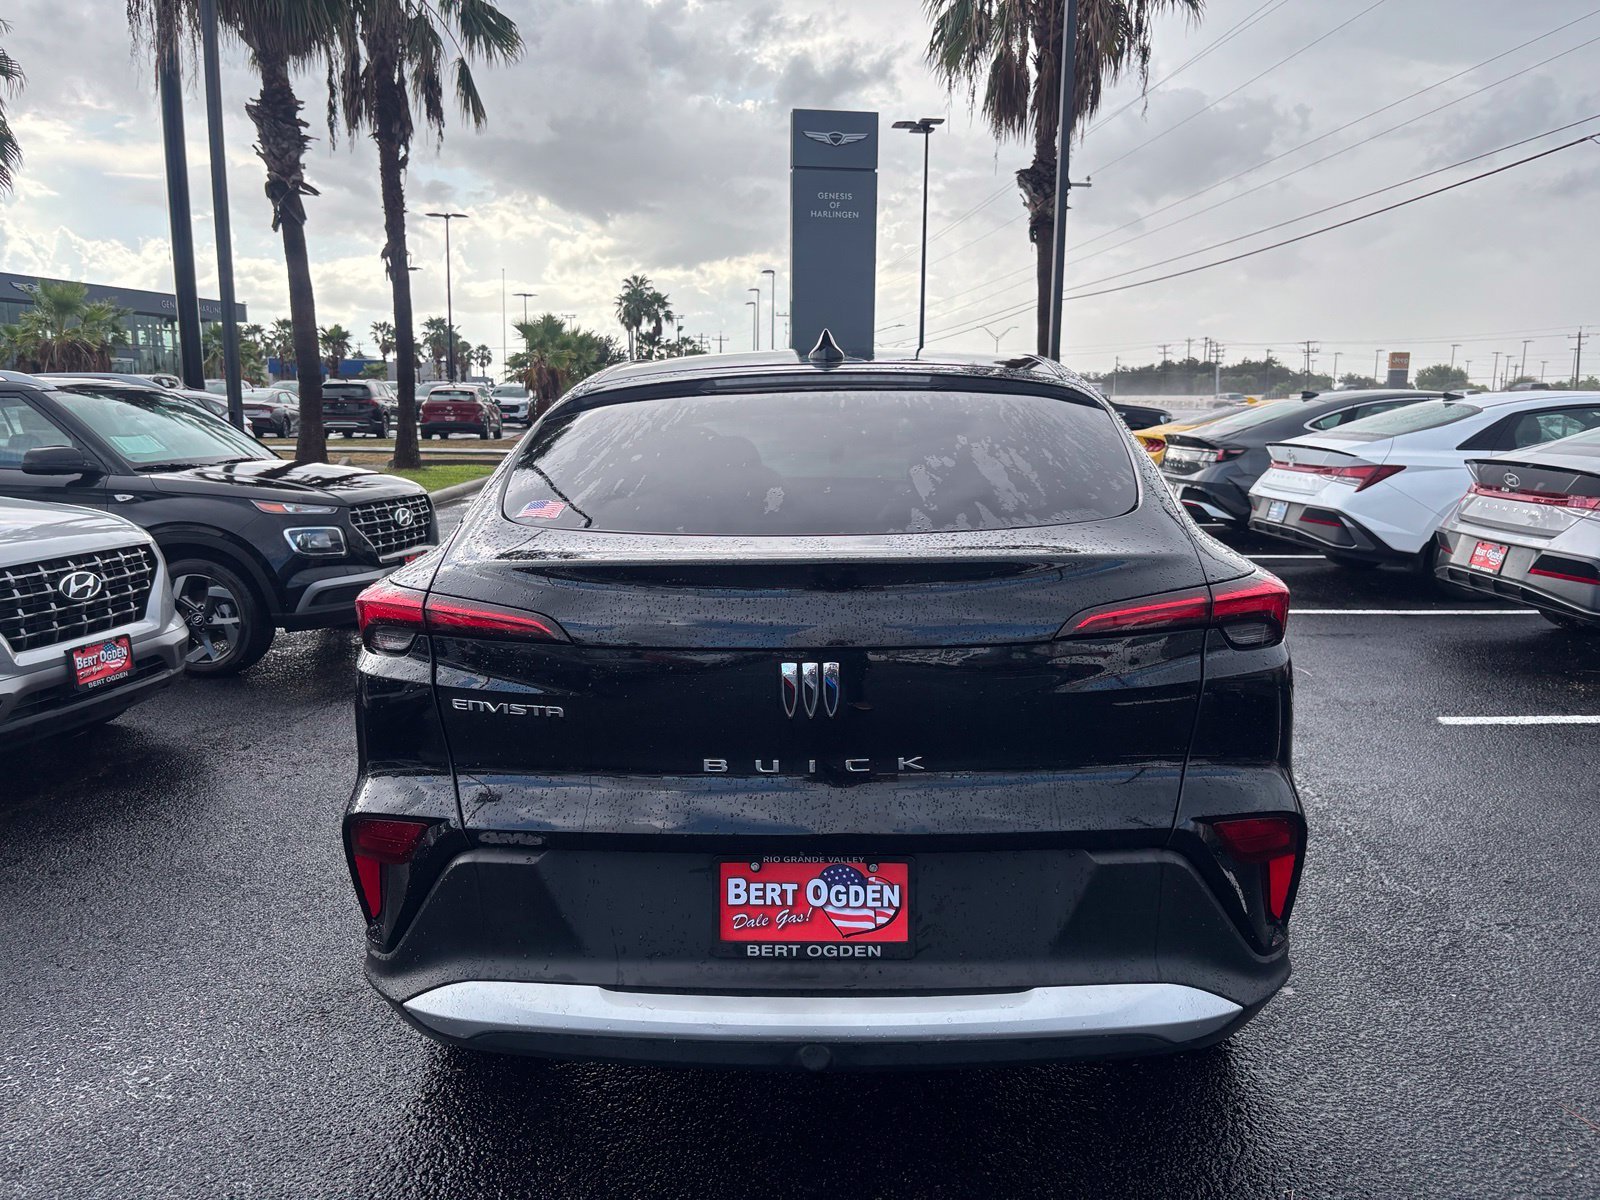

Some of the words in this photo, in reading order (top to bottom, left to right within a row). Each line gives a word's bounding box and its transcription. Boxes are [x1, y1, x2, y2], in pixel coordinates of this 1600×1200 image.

[817, 192, 853, 200] GENESIS
[829, 201, 841, 209] OF
[810, 210, 859, 219] HARLINGEN
[76, 655, 98, 670] BERT
[100, 647, 127, 662] OGDEN
[88, 679, 104, 688] BERT
[106, 671, 128, 682] OGDEN
[703, 756, 925, 774] BUICK
[727, 877, 798, 906] BERT
[806, 878, 900, 908] OGDEN
[732, 913, 770, 930] Dale
[775, 907, 813, 930] Gas!
[747, 945, 800, 957] BERT
[806, 945, 881, 957] OGDEN
